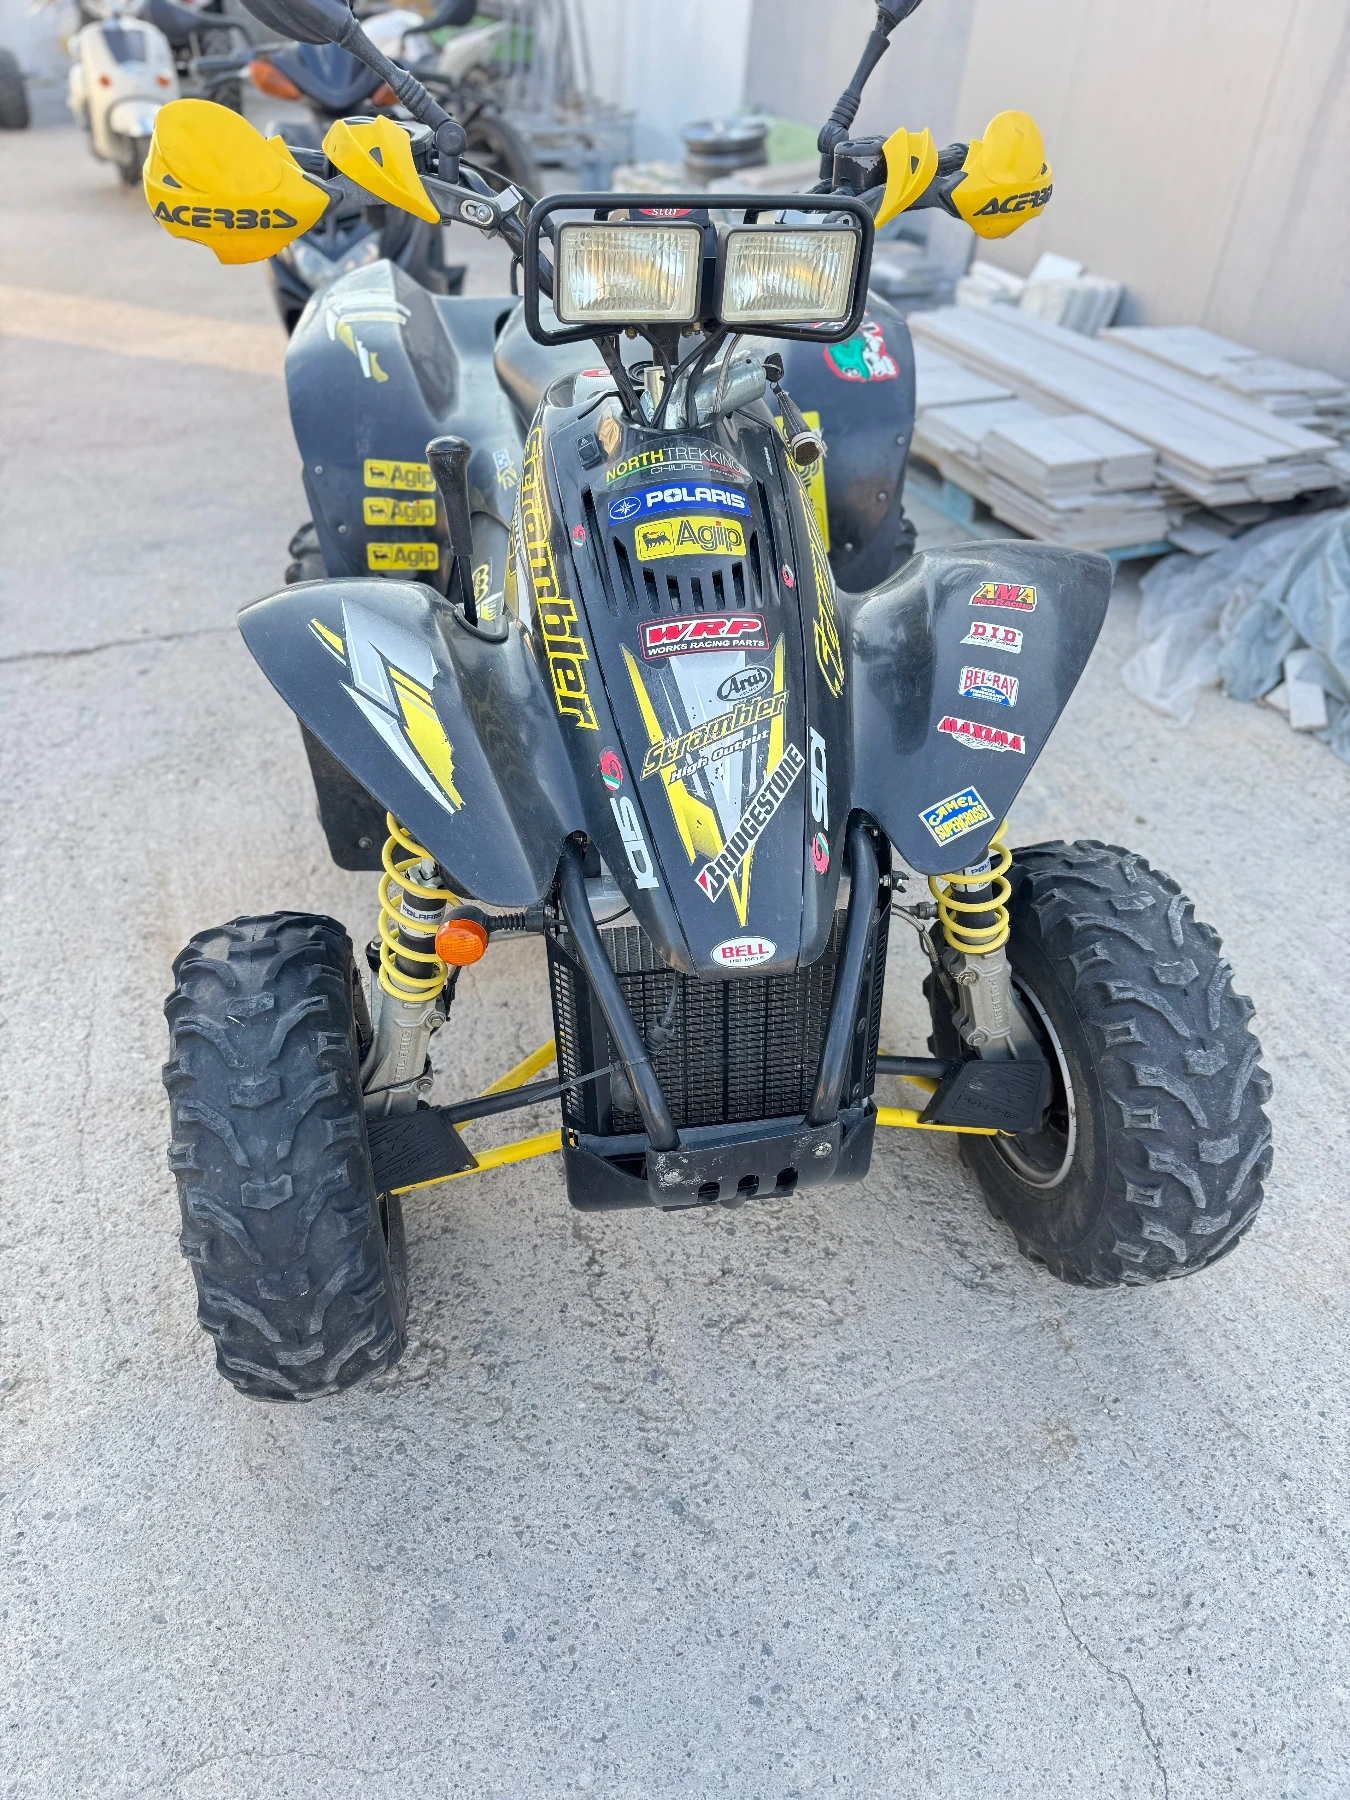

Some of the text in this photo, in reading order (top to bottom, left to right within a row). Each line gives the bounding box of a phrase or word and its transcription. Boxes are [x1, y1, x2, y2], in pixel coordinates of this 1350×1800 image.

[155, 201, 298, 229] ACERBIS
[646, 487, 746, 509] POLARIS
[676, 520, 742, 552] Agip
[394, 545, 436, 567] Agip
[521, 427, 600, 731] Scrambler
[974, 583, 1036, 605] AMA
[995, 598, 1034, 611] RACING
[648, 619, 761, 646] WRP
[648, 639, 765, 656] WORKS RACING PARTS
[723, 668, 767, 699] Arai
[641, 690, 790, 781] Scrambler
[938, 717, 1022, 752] MAXIMA
[668, 731, 770, 786] High Output
[703, 747, 805, 891] BRIDGESTONE
[928, 795, 979, 826] CAMEL
[934, 804, 988, 840] SUPERCROSS
[721, 944, 770, 959] BELL
